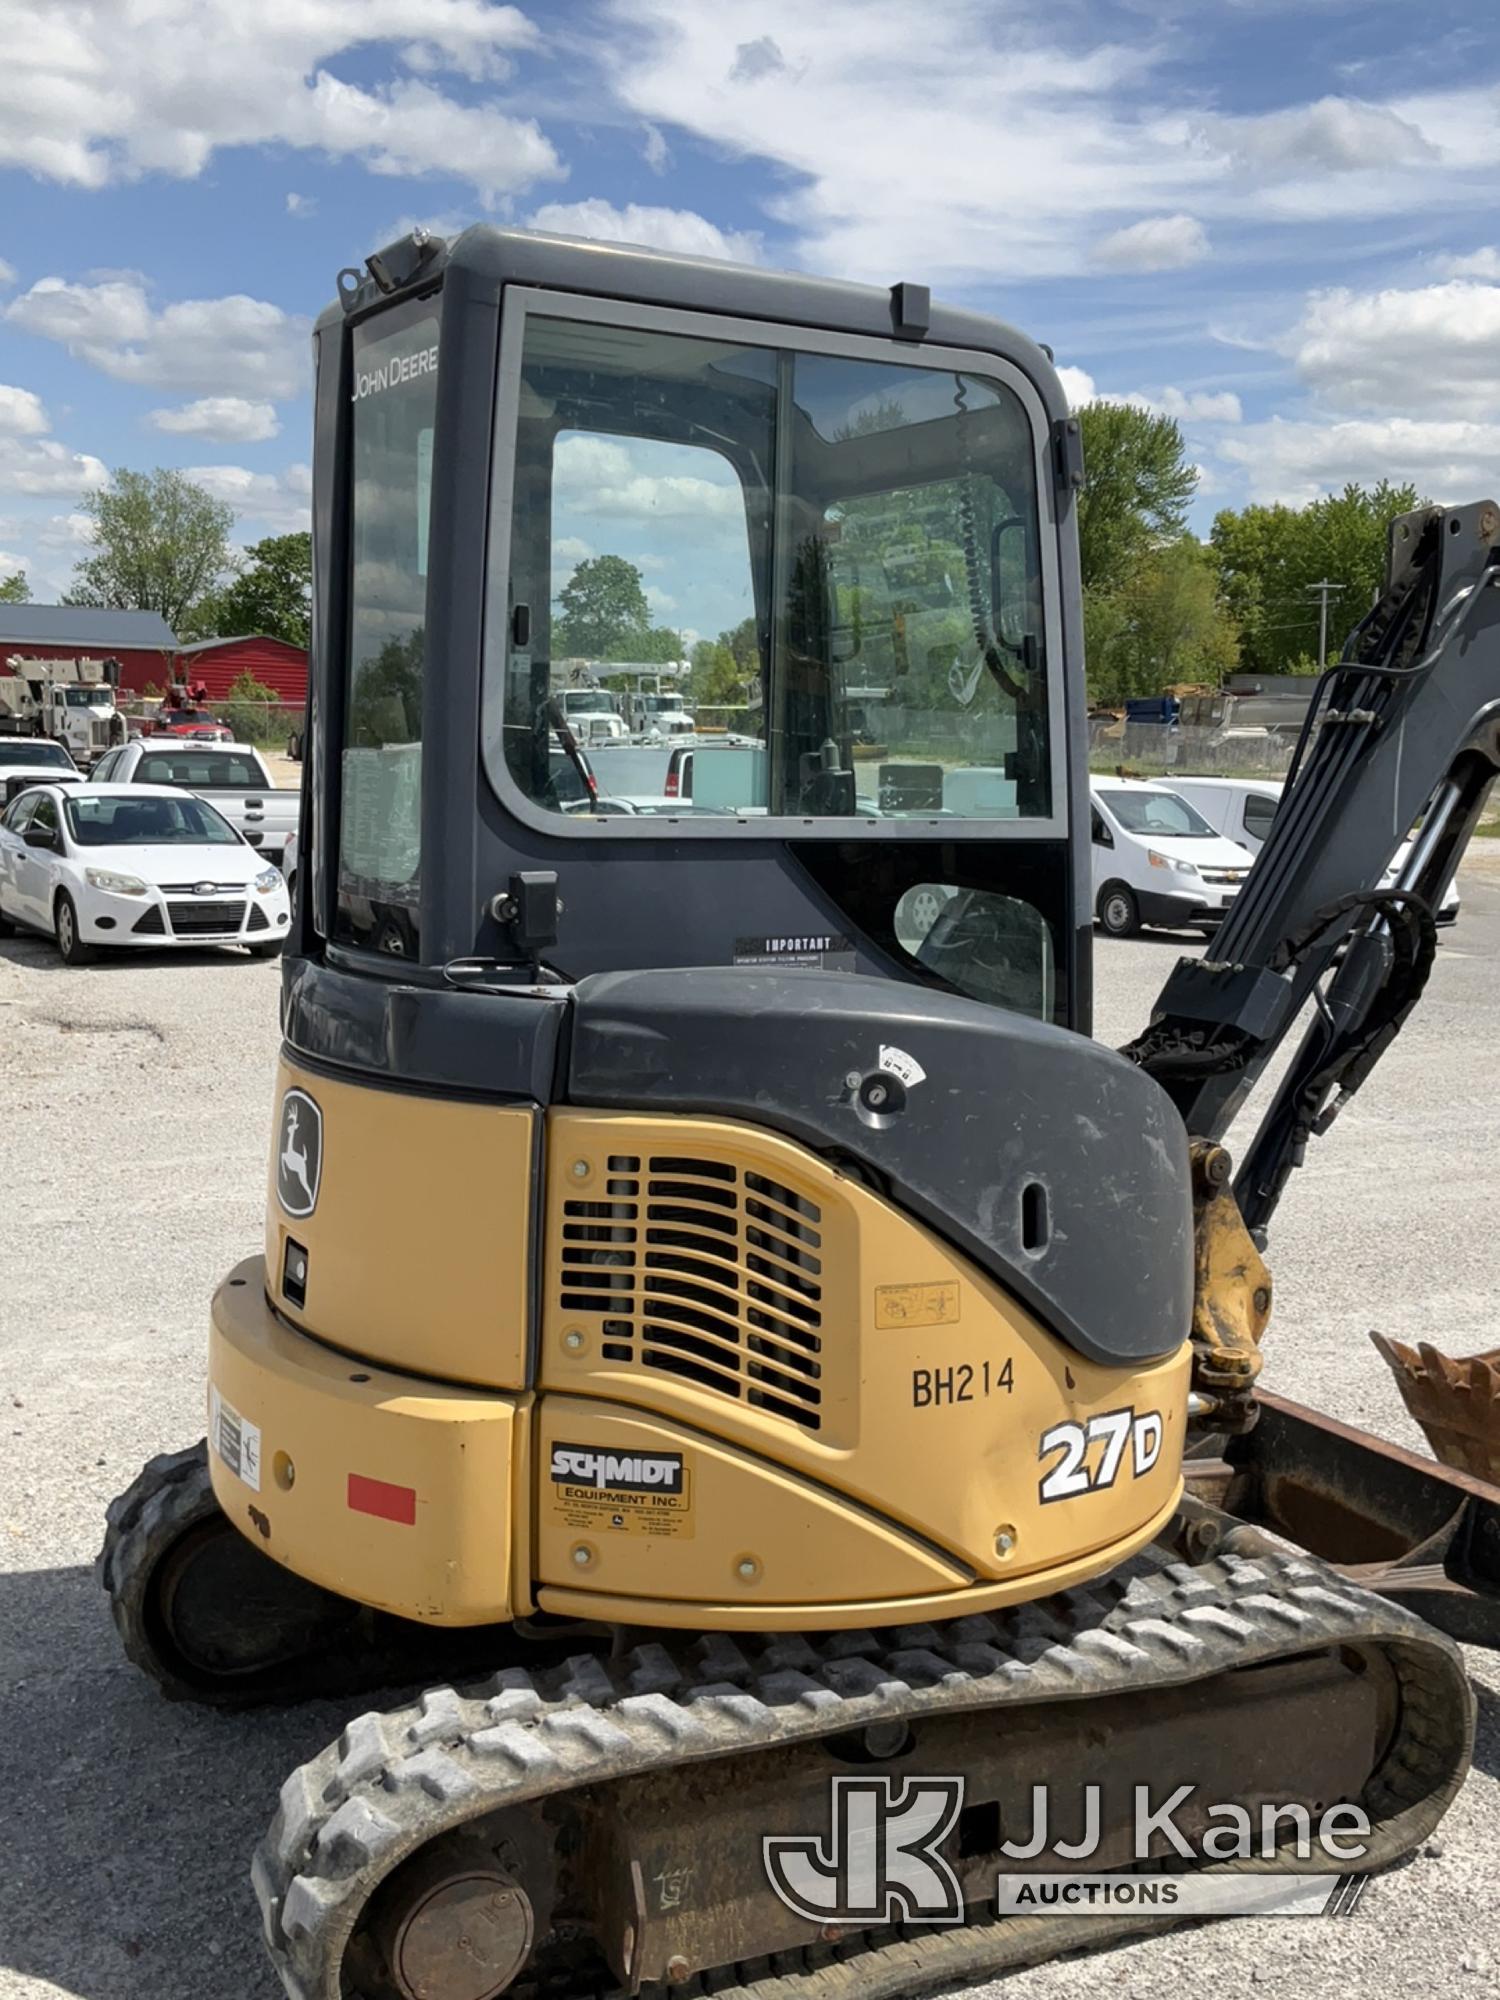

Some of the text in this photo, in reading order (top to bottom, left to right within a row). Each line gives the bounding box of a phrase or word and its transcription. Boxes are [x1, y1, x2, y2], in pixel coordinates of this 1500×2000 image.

[351, 345, 439, 402] JOHN DEERE
[765, 937, 831, 952] IMPORTANT
[913, 1357, 1014, 1408] BH214
[551, 1450, 680, 1488] SCHMIDT
[1038, 1405, 1164, 1505] 27D
[565, 1487, 682, 1508] EQUIPMENT INC.
